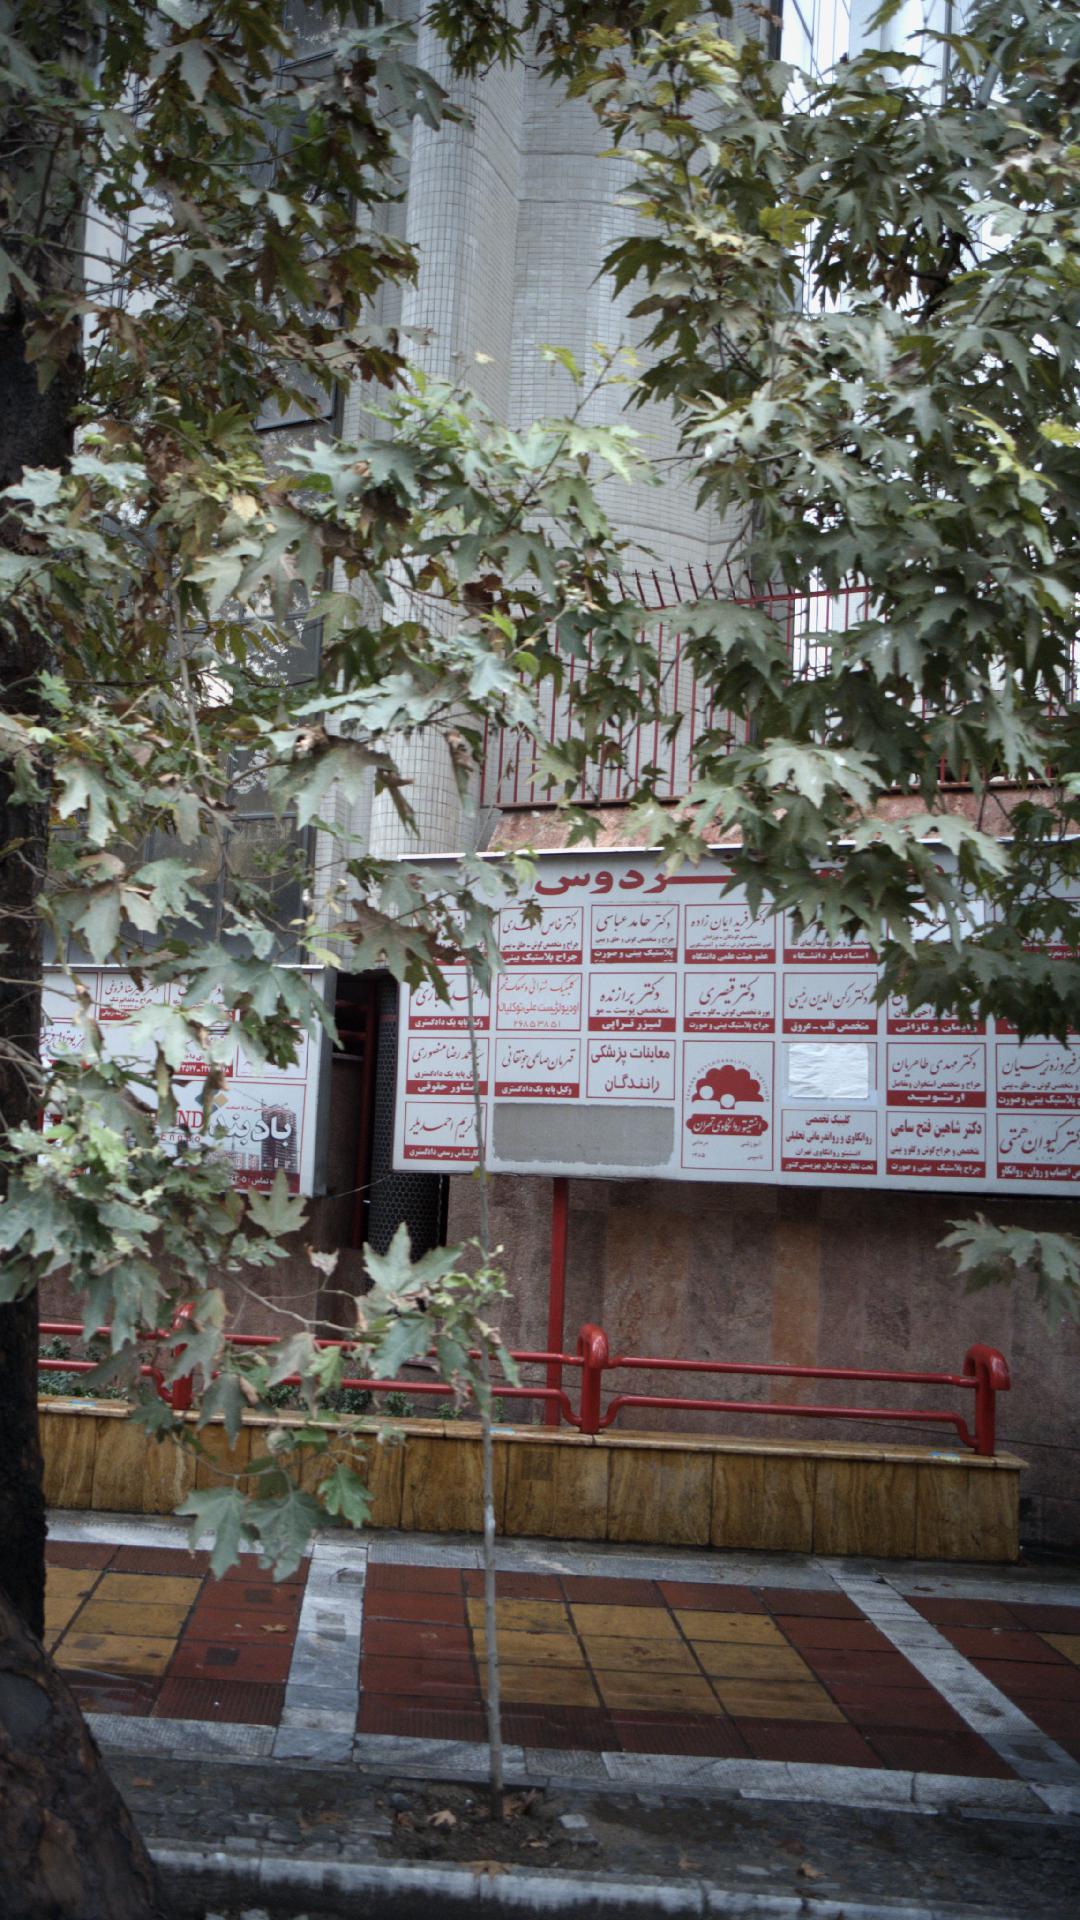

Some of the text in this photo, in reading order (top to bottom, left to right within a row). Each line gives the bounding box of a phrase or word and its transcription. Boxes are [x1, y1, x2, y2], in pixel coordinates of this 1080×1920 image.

[534, 869, 738, 896] ردوس
[560, 910, 579, 933] دکتر
[596, 907, 674, 934] دکتر حامد عباسی
[734, 910, 749, 933] فرید
[503, 952, 578, 964] جراح پلاستیک بینی
[593, 951, 618, 959] صورت
[625, 950, 643, 959] بینی
[643, 949, 673, 958] پلاستیک
[691, 952, 717, 960] دانشگاه
[717, 952, 735, 962] علمی
[828, 951, 869, 961] استادیار
[600, 976, 665, 1005] دکتر برازنده
[698, 976, 760, 1006] دکتر قیصری
[848, 982, 872, 1009] دکتر
[613, 1007, 636, 1016] پوست
[637, 1006, 669, 1015] متخصص
[415, 1018, 445, 1028] دادگستری
[446, 1018, 457, 1028] یک
[601, 1018, 662, 1030] لیزر تراپی
[689, 1022, 708, 1030] صورت
[713, 1022, 728, 1030] بینی
[727, 1020, 752, 1030] پلاستیک
[753, 1021, 769, 1031] جراح
[791, 1020, 869, 1032] متخصص قلب عروق
[942, 1022, 977, 1032] زایمان
[547, 1048, 576, 1070] قهرمان
[591, 1044, 671, 1066] معاینات پزشکی
[892, 1047, 981, 1078] دکتر مهدی طاهریان
[414, 1071, 443, 1079] دادگستری
[443, 1071, 454, 1079] یک
[417, 1081, 448, 1093] حقوقی
[604, 1073, 660, 1093] رانندگان
[501, 1085, 572, 1095] وکیل پایه یک دادگستری
[997, 1095, 1020, 1106] صورت
[1027, 1095, 1043, 1106] بینی
[1045, 1094, 1076, 1107] پلاستیک
[693, 1116, 717, 1133] تهران
[891, 1117, 982, 1140] دکتر شاهین فتح سامی
[999, 1128, 1028, 1154] همتی
[409, 1147, 479, 1158] کارشناس رسمی دادگستری
[891, 1163, 911, 1171] صورت
[917, 1164, 932, 1173] بینی
[936, 1164, 963, 1173] پلاستیک
[963, 1165, 982, 1175] جراح
